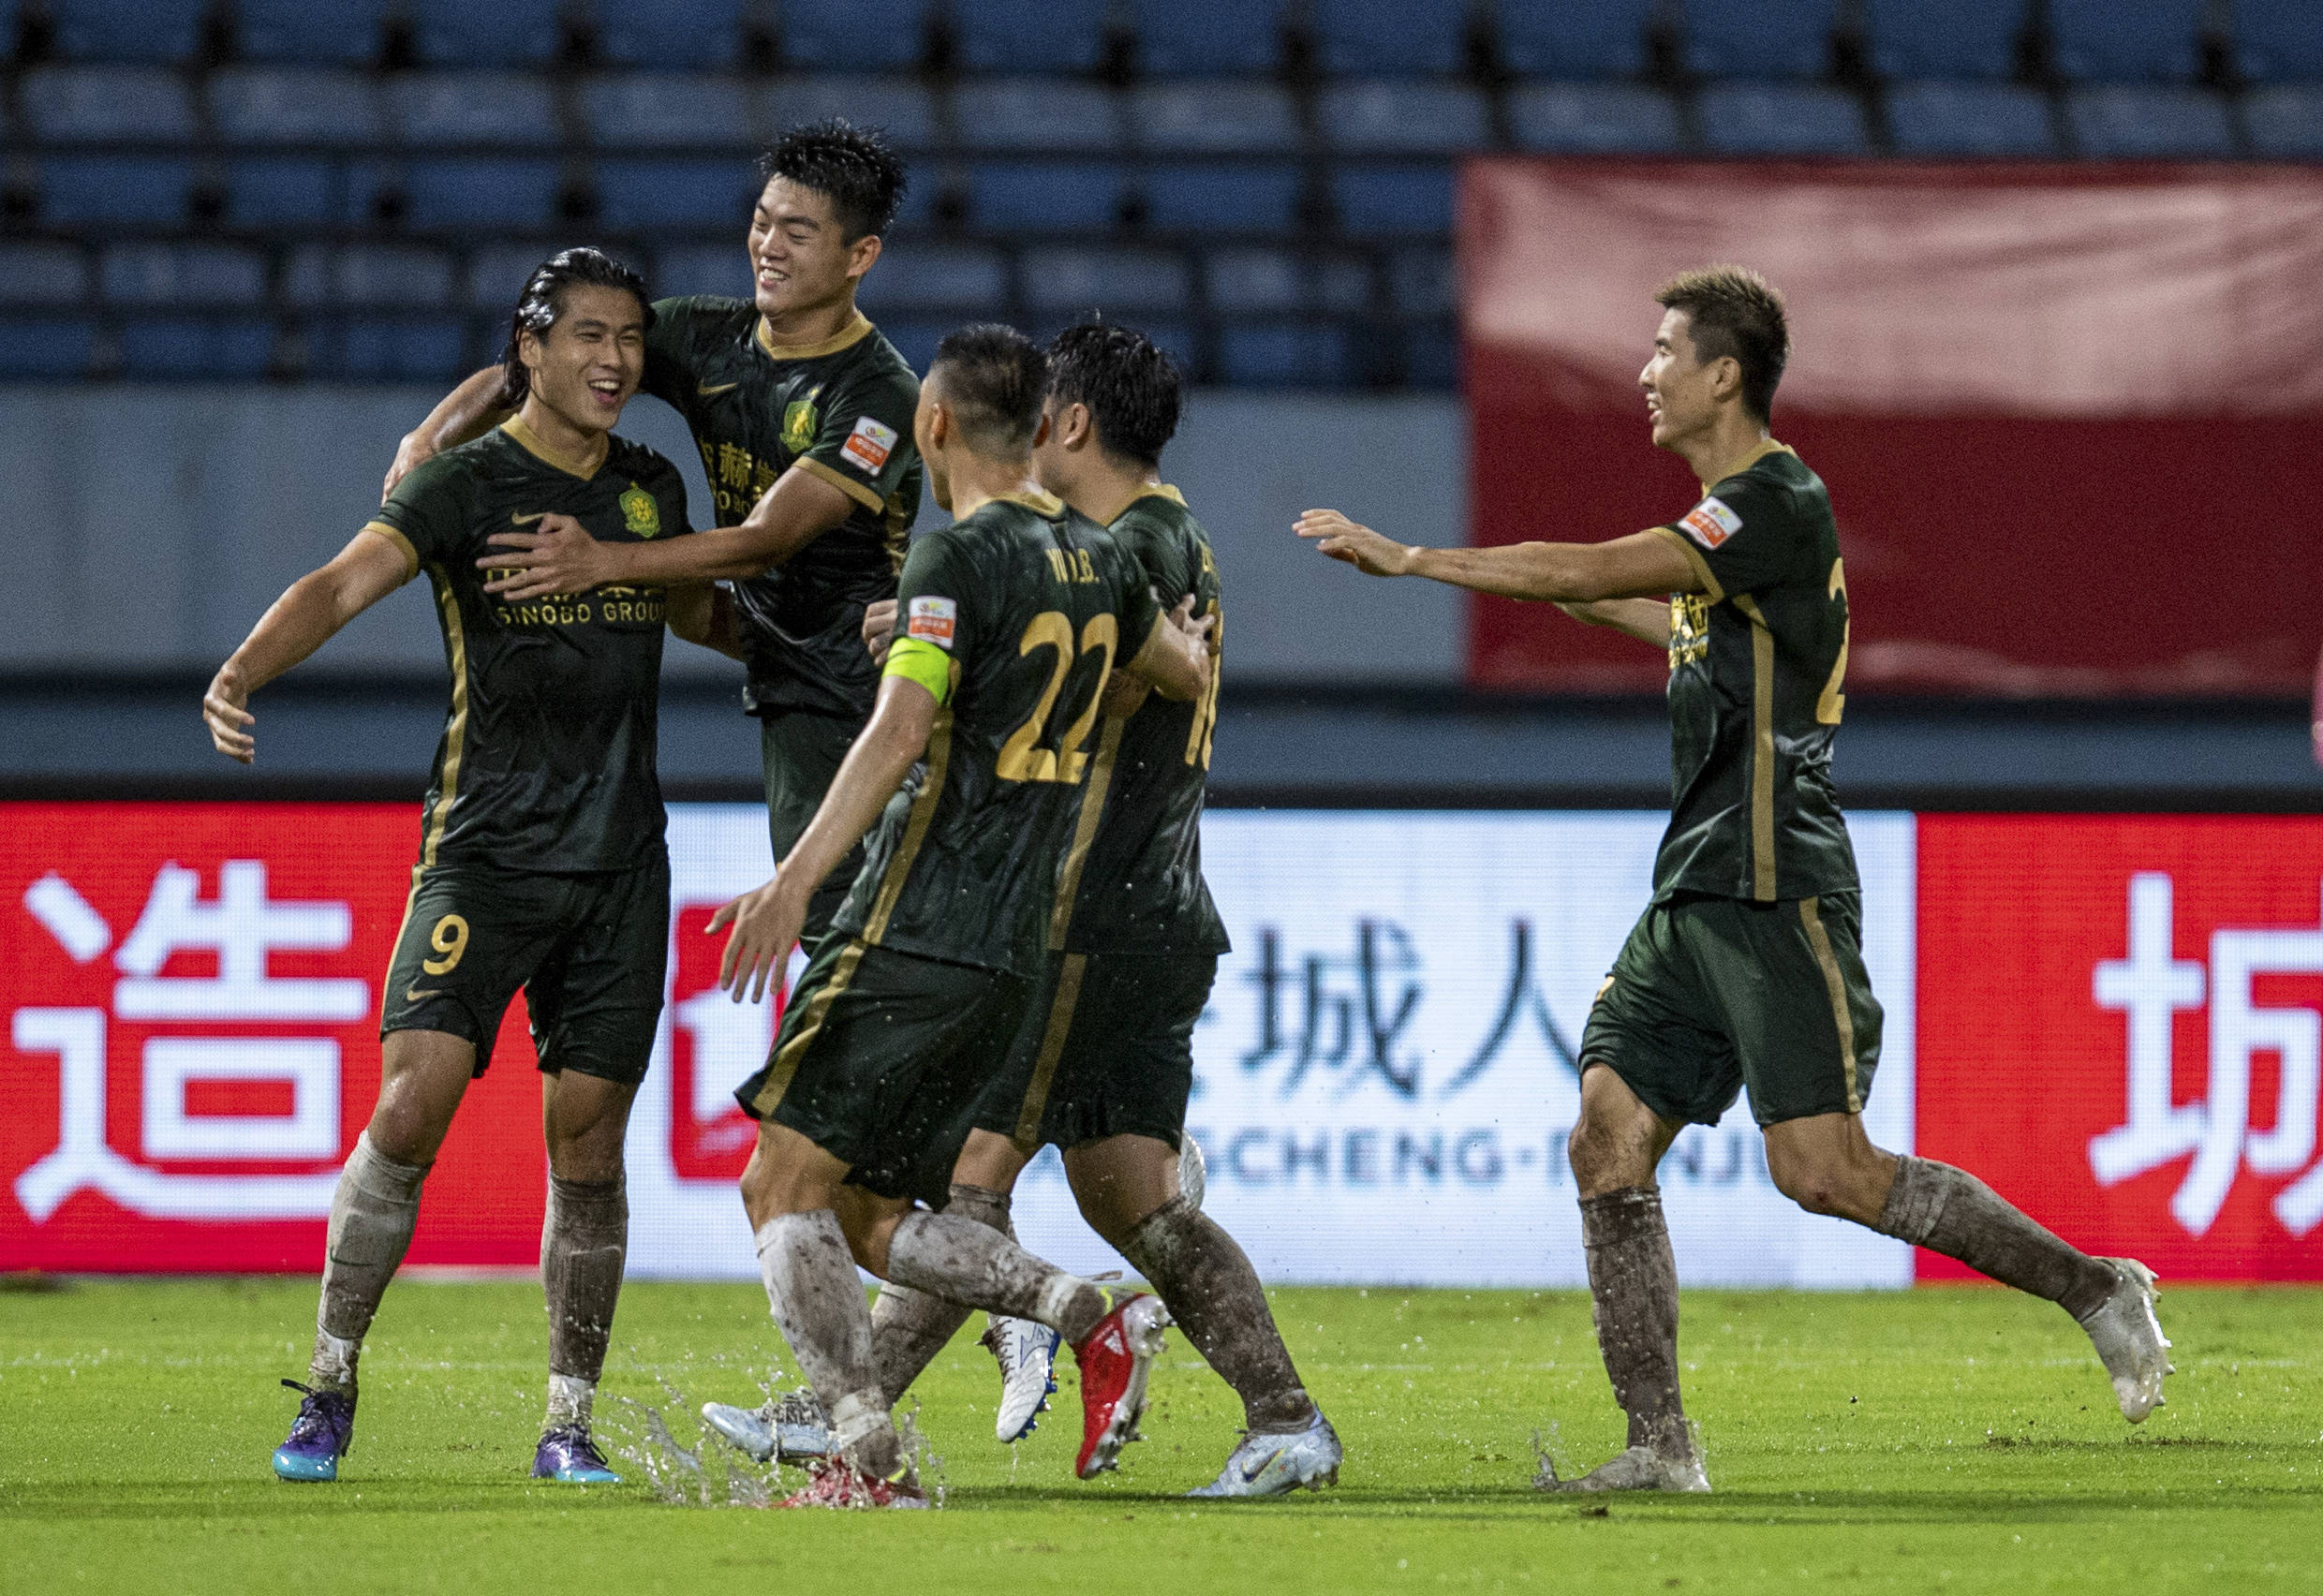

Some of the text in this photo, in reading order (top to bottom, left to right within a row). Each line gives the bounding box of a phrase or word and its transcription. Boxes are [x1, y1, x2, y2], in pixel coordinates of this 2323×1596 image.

[496, 601, 666, 626] SINOBO GROU
[996, 611, 1119, 784] 22
[422, 913, 469, 975] 9
[1190, 916, 1581, 1100] 城人
[12, 858, 369, 1221] 造
